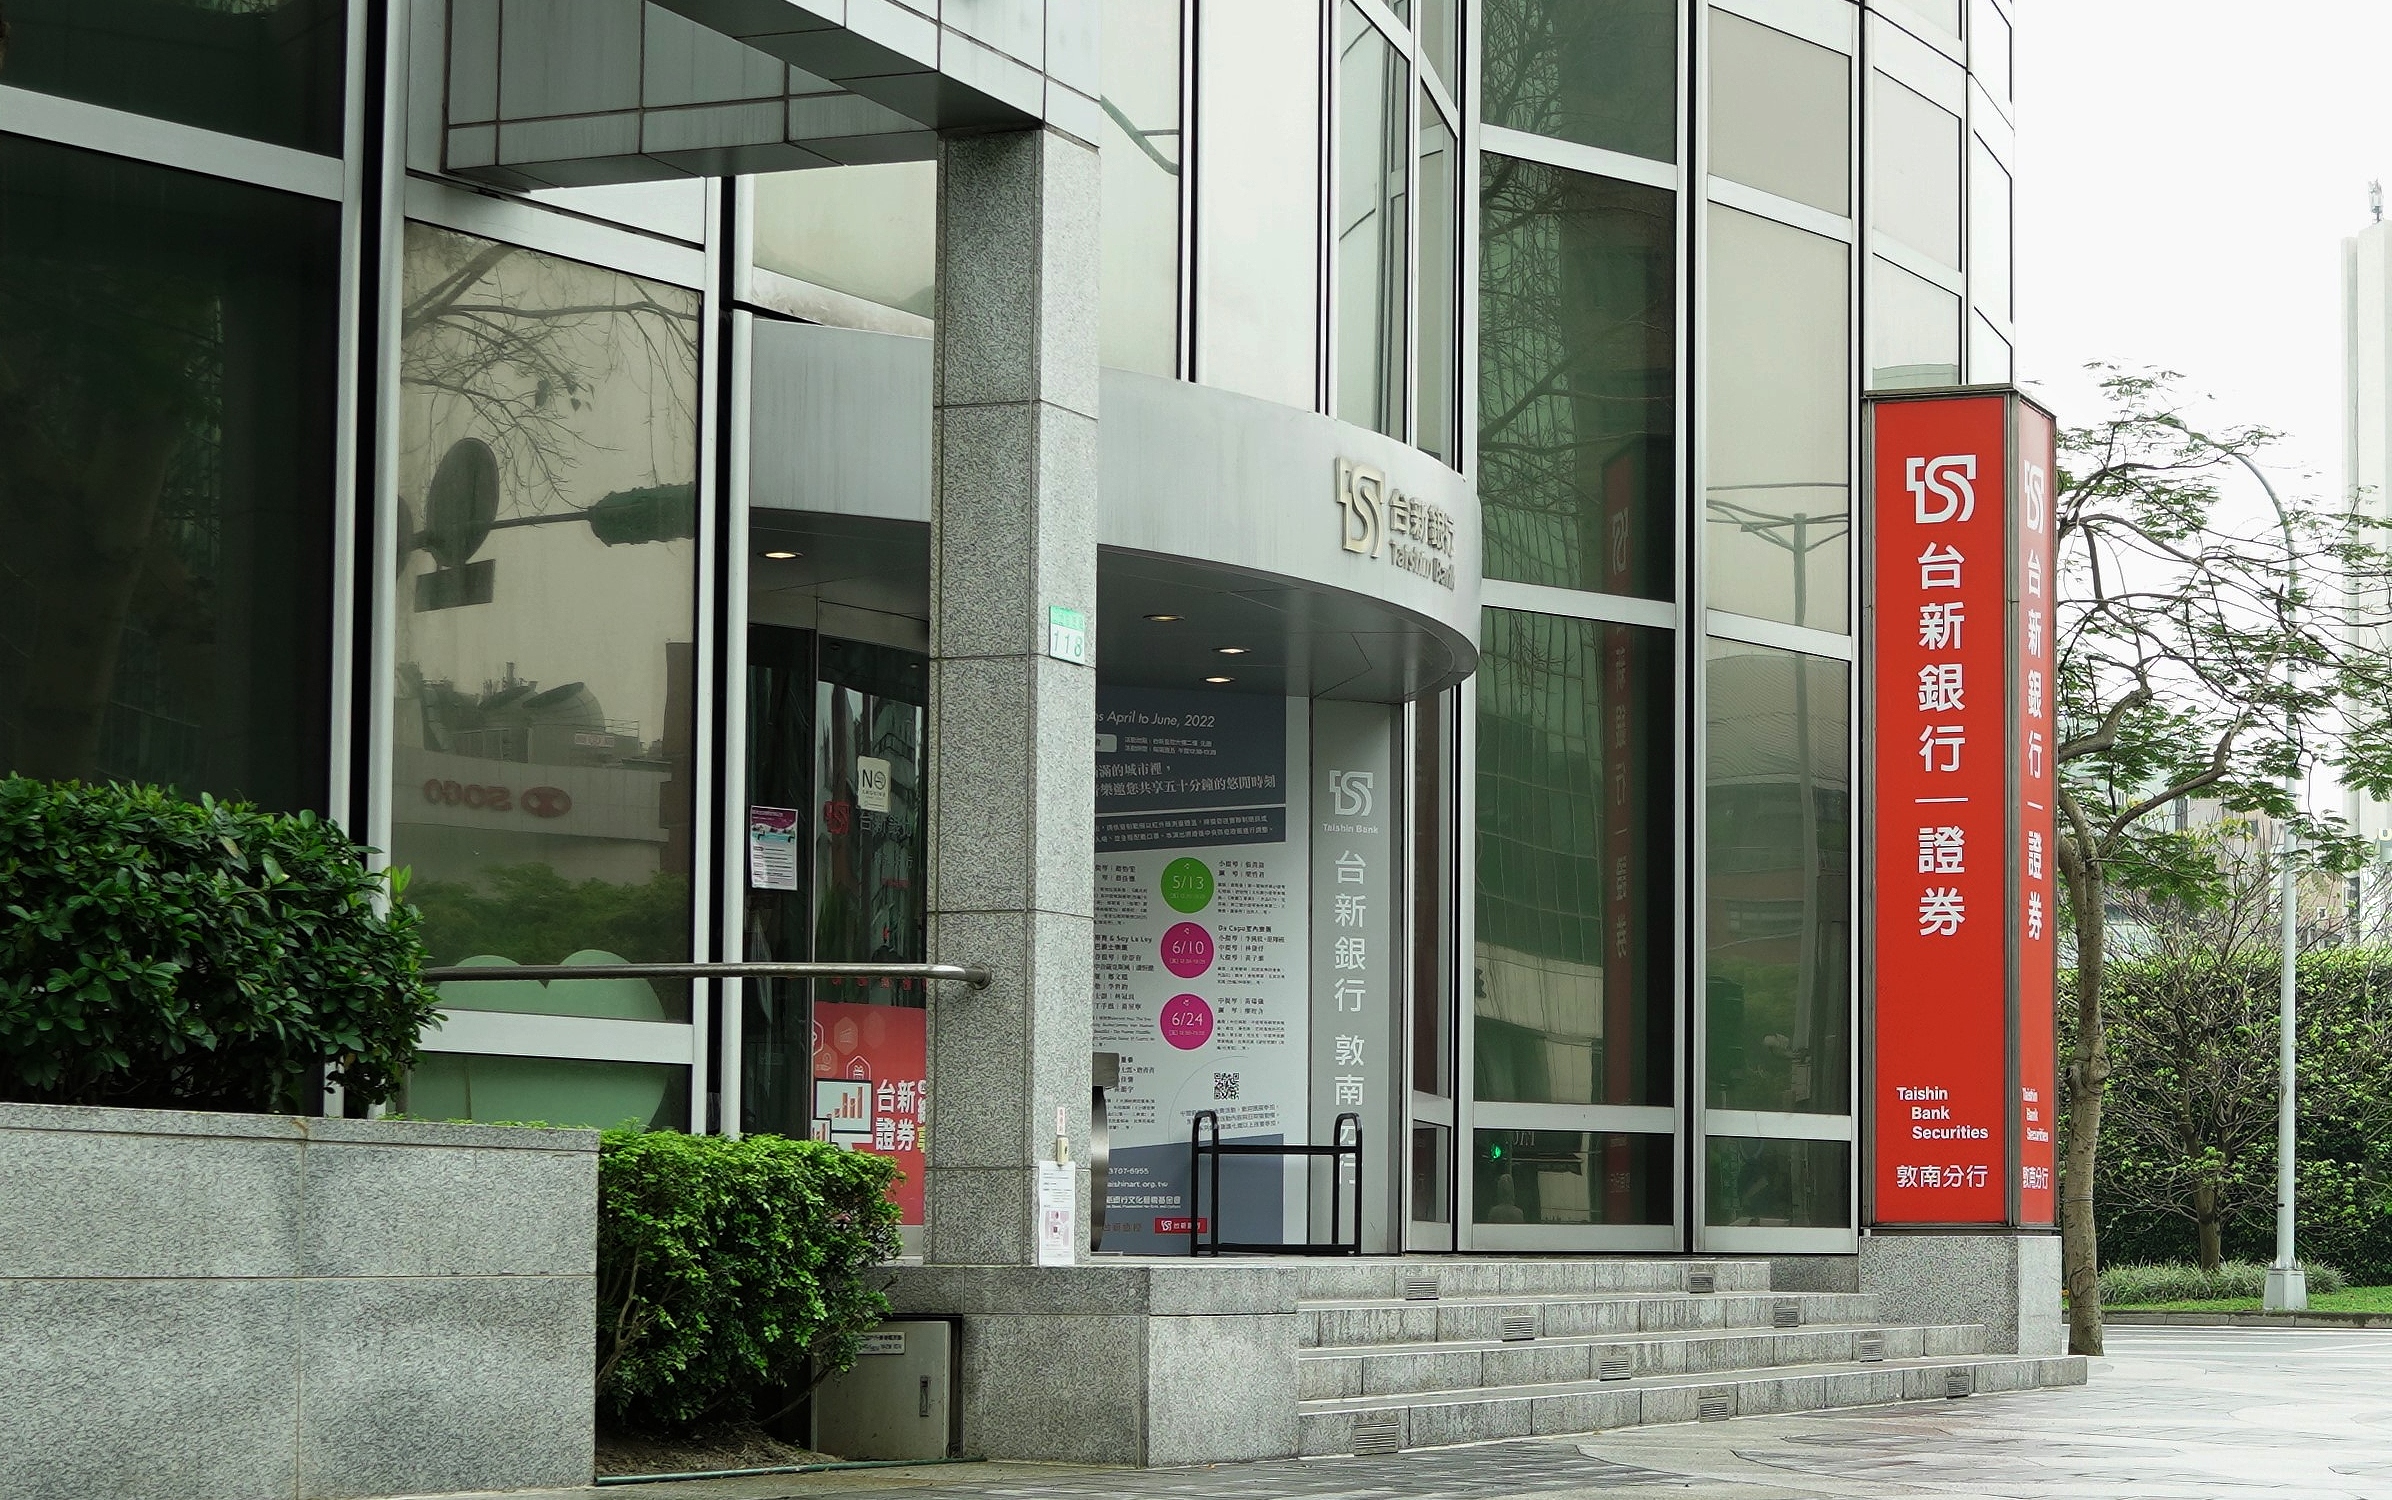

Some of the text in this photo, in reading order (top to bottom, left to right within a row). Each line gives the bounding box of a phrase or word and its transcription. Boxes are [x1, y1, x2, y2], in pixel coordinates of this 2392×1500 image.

[1389, 488, 1455, 558] 台新銀行
[1107, 710, 1136, 726] April
[1138, 711, 1150, 725] to
[1150, 712, 1182, 728] June,
[1183, 713, 1217, 728] 2022
[1917, 541, 1966, 937] 台新銀行 證券
[2027, 549, 2043, 942] 台新銀行 證券
[1323, 823, 1379, 834] Taishin Bank
[1172, 874, 1204, 890] 5/13
[1334, 850, 1366, 1012] 台新銀行
[1172, 940, 1204, 955] 6/10
[1171, 1012, 1203, 1026] 6/24
[875, 1079, 916, 1115] 台新
[1896, 1086, 1948, 1101] Taishin
[1911, 1105, 1950, 1120] Bank
[875, 1117, 916, 1151] 證券
[1912, 1125, 1989, 1140] Securities
[1896, 1164, 1988, 1188] 敦南分行
